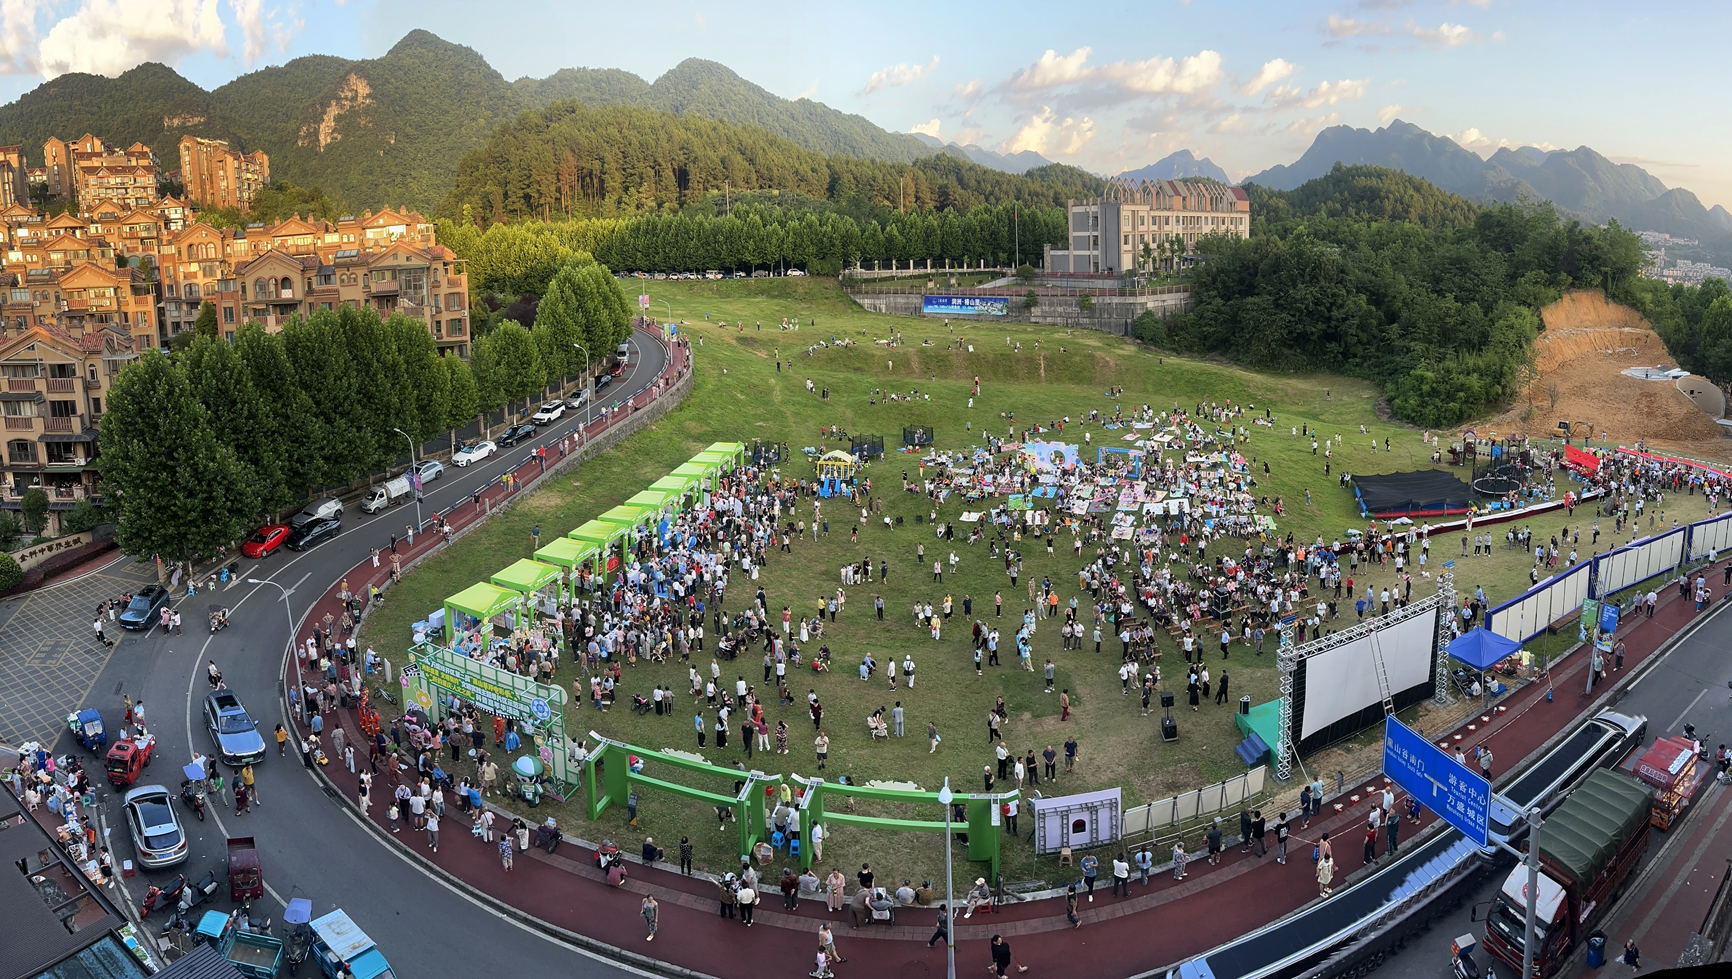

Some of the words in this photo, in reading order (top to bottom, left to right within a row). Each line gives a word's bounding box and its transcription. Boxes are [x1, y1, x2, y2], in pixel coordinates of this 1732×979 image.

[1448, 772, 1486, 806] 游客中心
[1451, 786, 1466, 801] Tourist
[1467, 797, 1483, 812] Centre
[1447, 793, 1485, 827] 万盛城区
